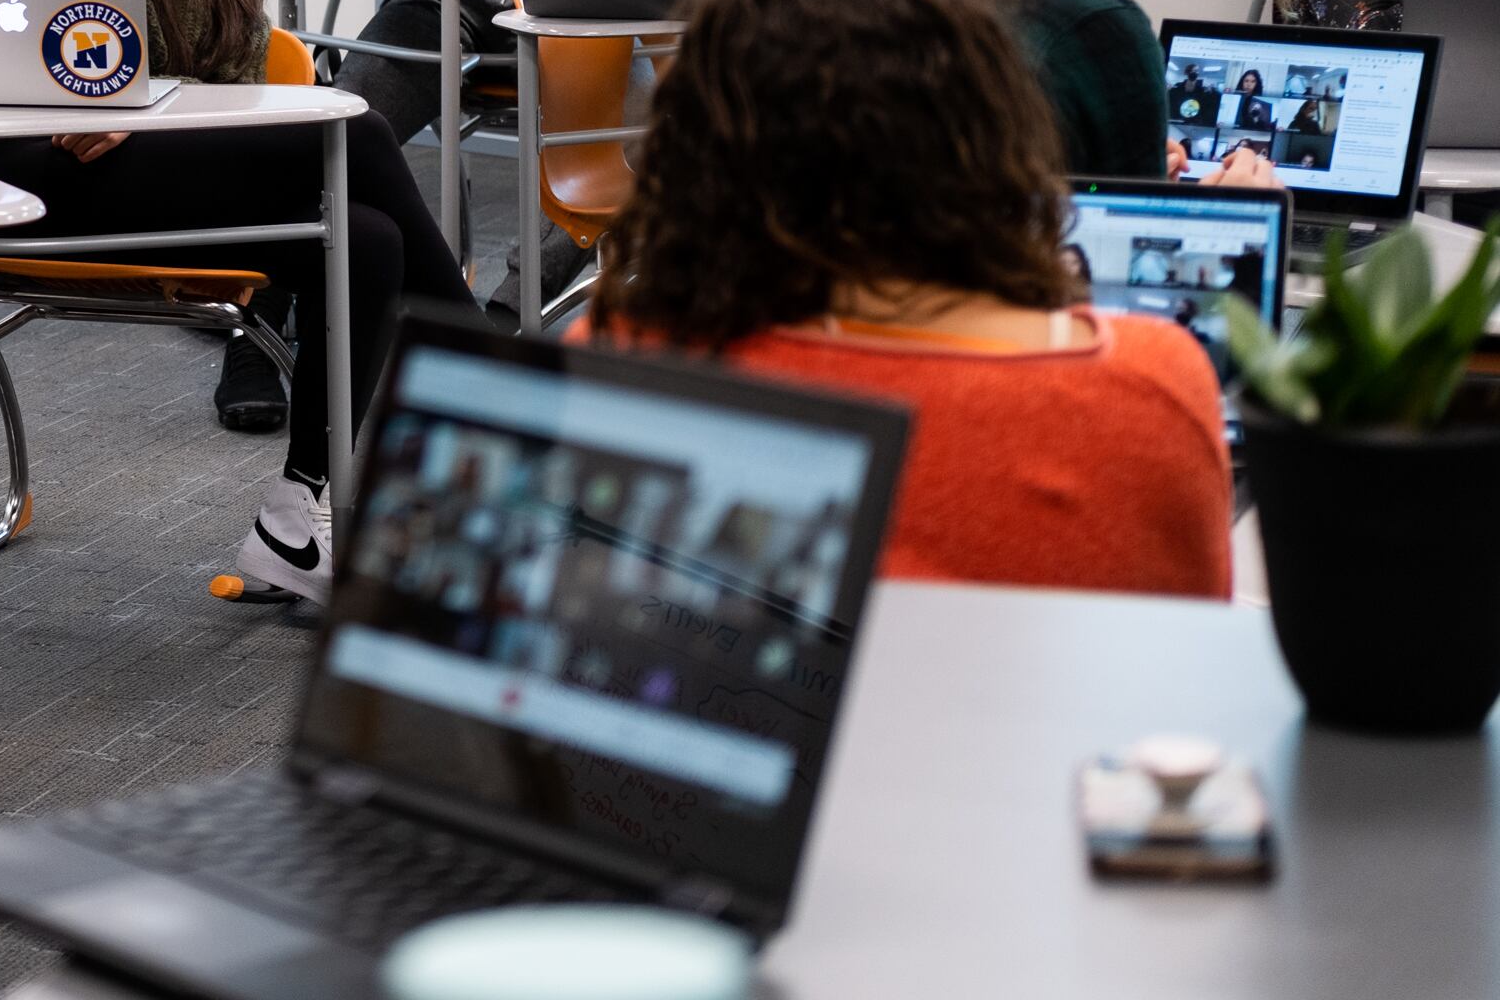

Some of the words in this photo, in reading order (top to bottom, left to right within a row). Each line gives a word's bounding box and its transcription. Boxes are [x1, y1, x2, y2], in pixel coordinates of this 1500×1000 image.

[49, 4, 133, 37] NORTHFIELD
[72, 31, 110, 69] N
[51, 62, 134, 95] NIGHTHAWKS
